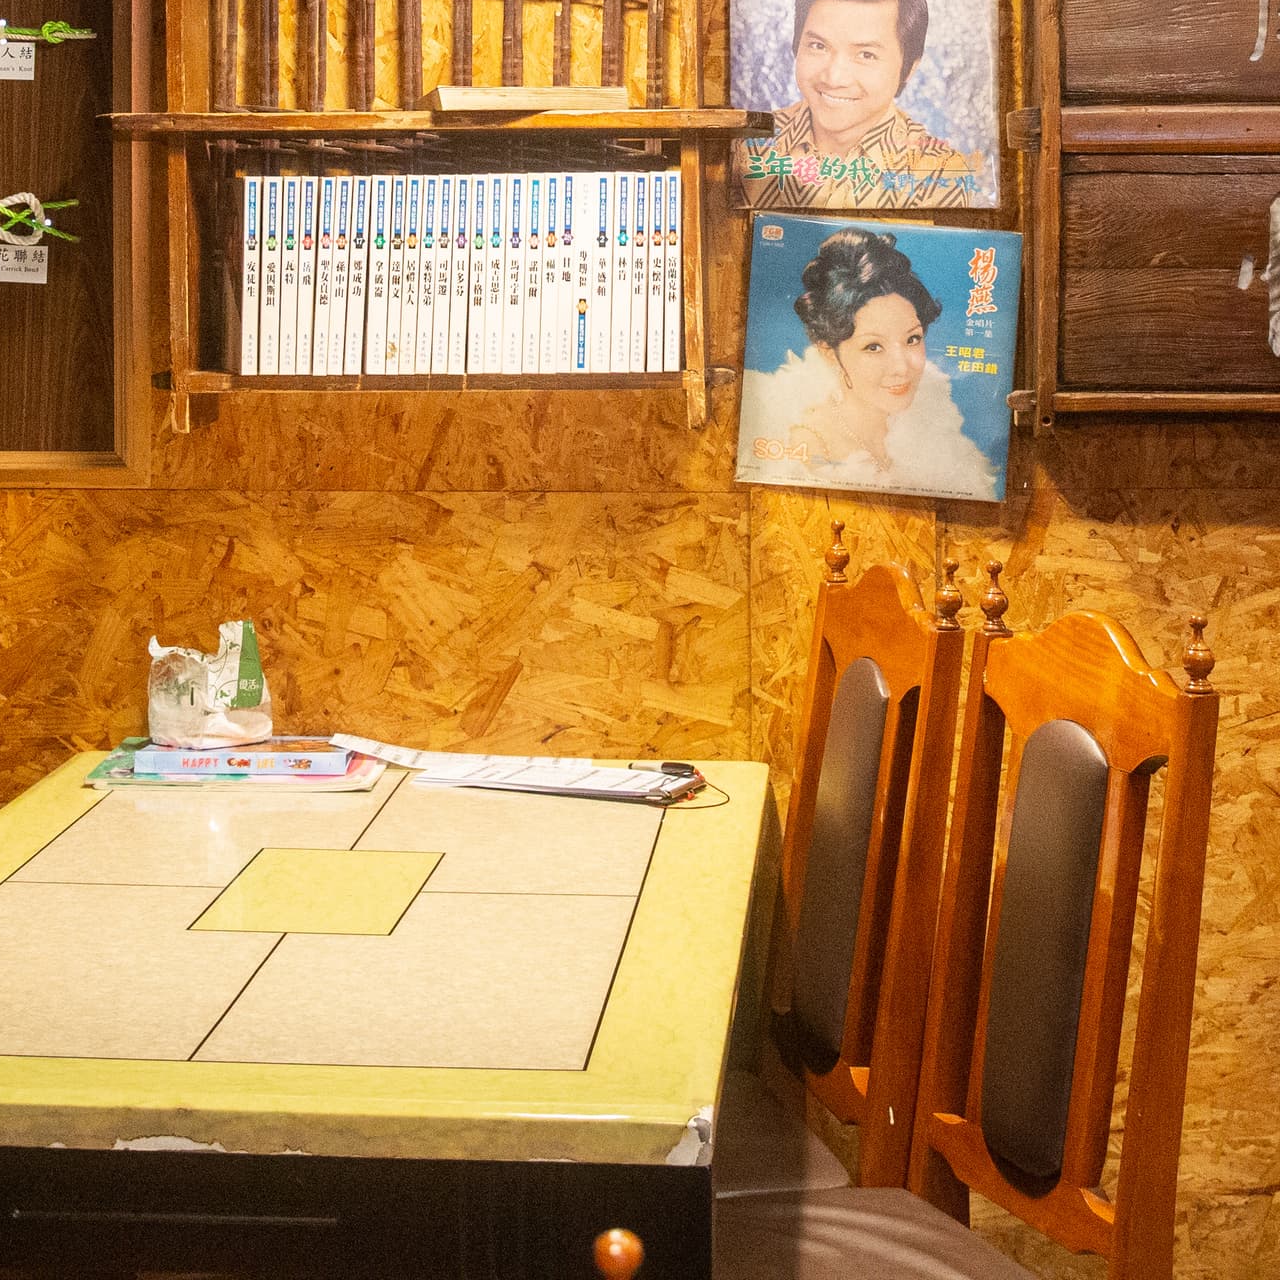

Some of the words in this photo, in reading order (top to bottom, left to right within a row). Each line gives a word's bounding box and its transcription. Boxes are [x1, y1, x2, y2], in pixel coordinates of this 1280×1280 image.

[247, 260, 256, 297] 安徒生
[334, 262, 345, 298] 孫中山
[352, 260, 363, 297] 鄭成功
[392, 260, 400, 299] 達爾文
[456, 260, 465, 297] 貝多芬
[966, 247, 998, 317] 楊燕
[946, 346, 985, 360] 王昭君
[182, 758, 219, 769] HAPPY
